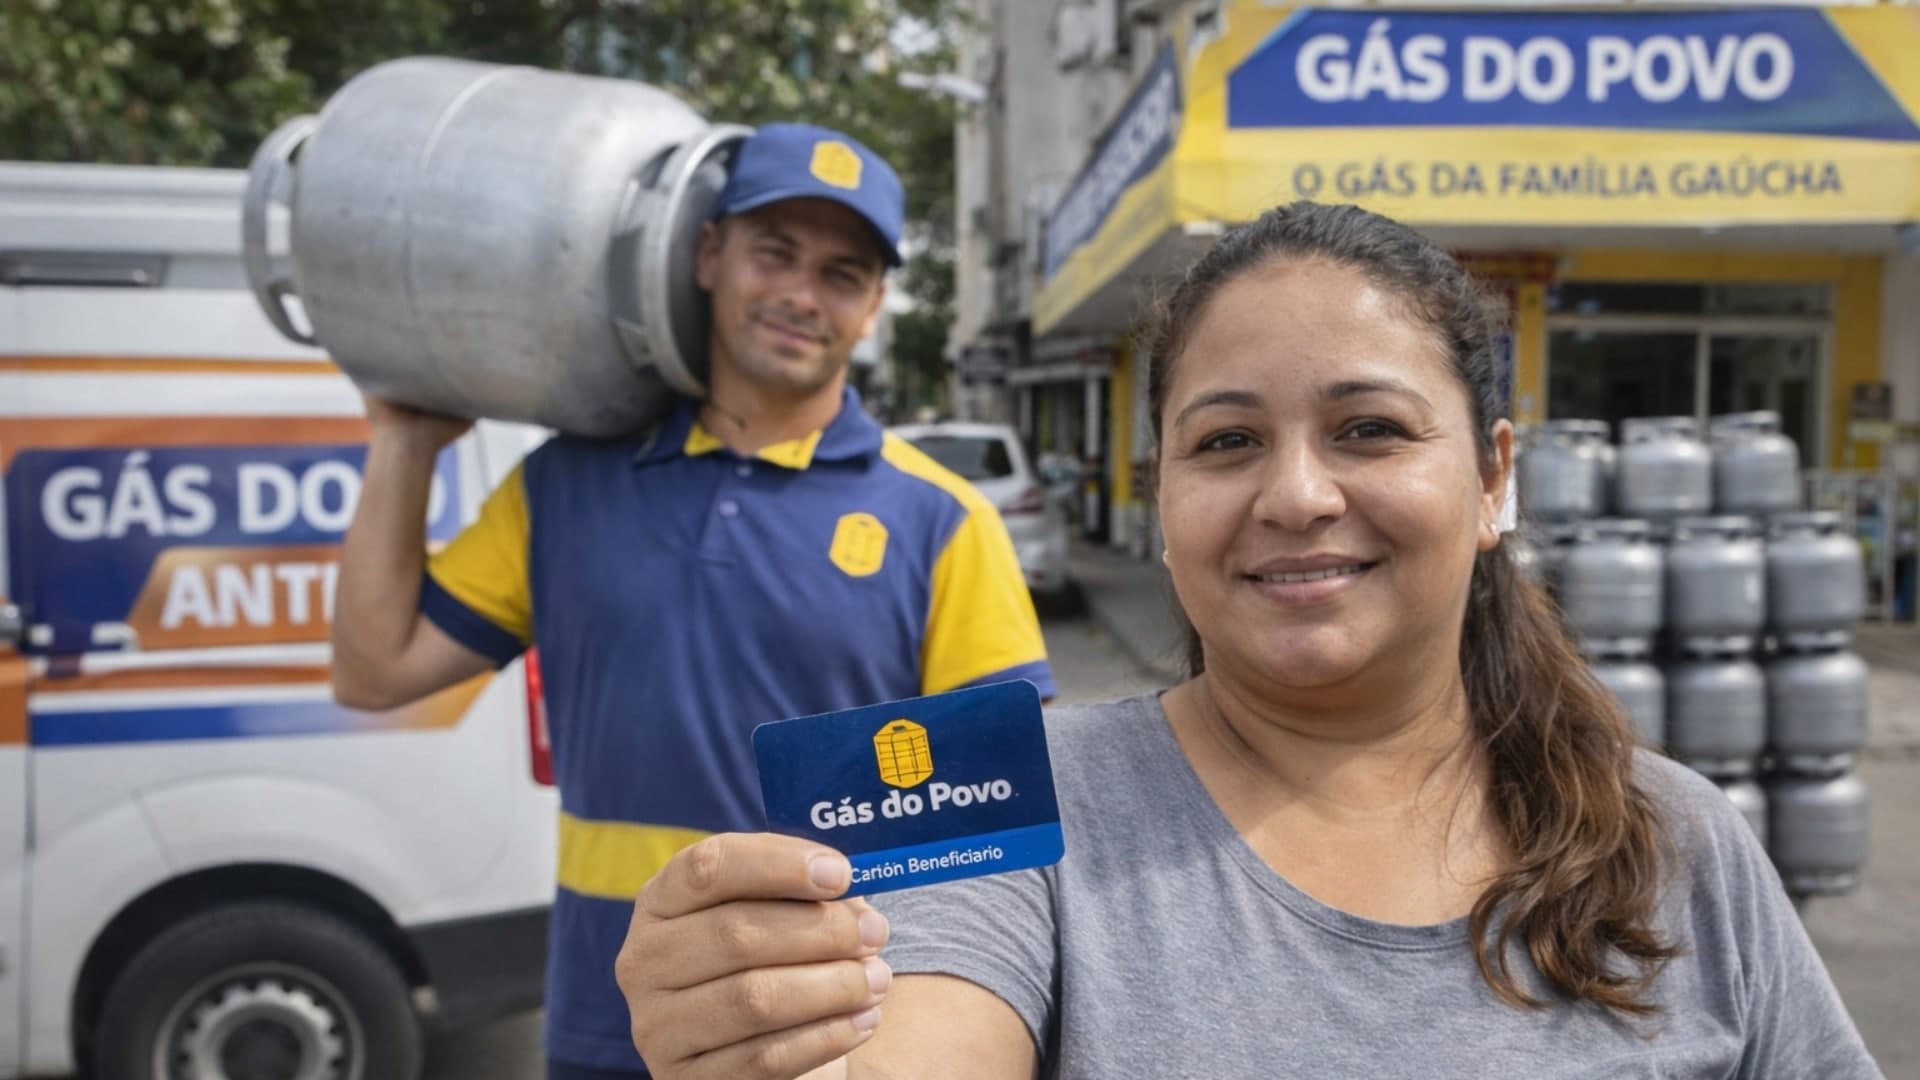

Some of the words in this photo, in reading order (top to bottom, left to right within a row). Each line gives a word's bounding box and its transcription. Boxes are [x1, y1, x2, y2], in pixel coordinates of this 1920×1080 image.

[1295, 17, 1450, 103] GÁS
[1462, 36, 1575, 104] DO
[1586, 32, 1794, 103] POVO
[1292, 161, 1324, 198] O
[1335, 153, 1417, 198] GÁS
[1428, 161, 1486, 198] DA
[1499, 153, 1659, 198] FAMÍLIA
[1668, 153, 1843, 198] GAÚCHA
[41, 450, 217, 541] GÁS
[236, 460, 362, 534] DO
[810, 796, 875, 830] Gás
[881, 789, 923, 819] do
[928, 779, 1012, 811] Povo
[908, 845, 1004, 873] Beneficiario
